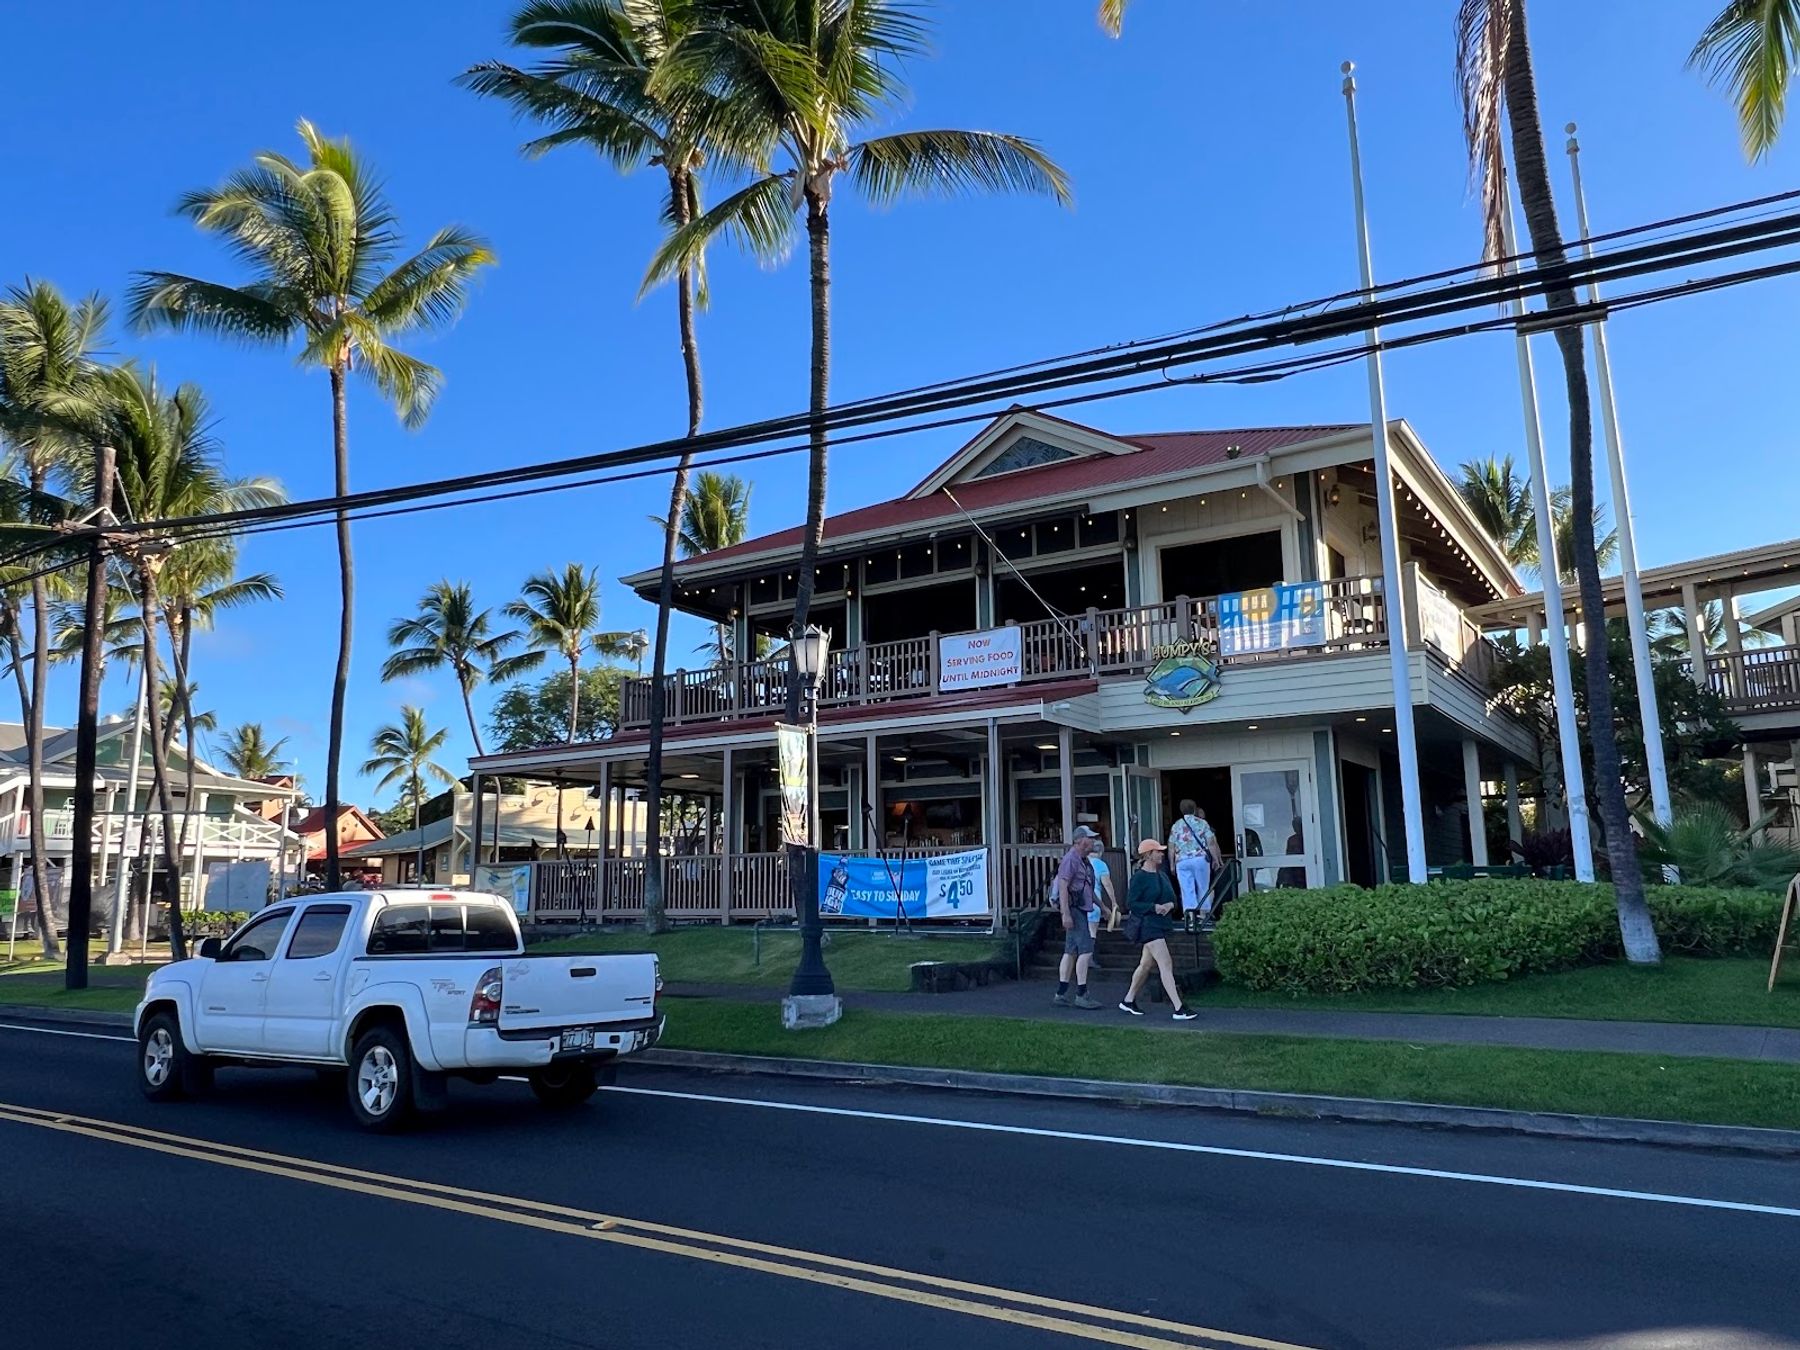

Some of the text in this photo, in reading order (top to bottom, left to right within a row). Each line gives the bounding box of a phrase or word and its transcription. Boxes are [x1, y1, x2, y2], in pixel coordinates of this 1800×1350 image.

[968, 639, 991, 649] NOW
[1152, 640, 1210, 660] HUMPY'S
[947, 651, 1014, 667] SERVING FOOD
[942, 666, 1019, 683] UNTIL MIDNIGHT
[851, 890, 872, 902] EASY
[874, 890, 885, 902] TO
